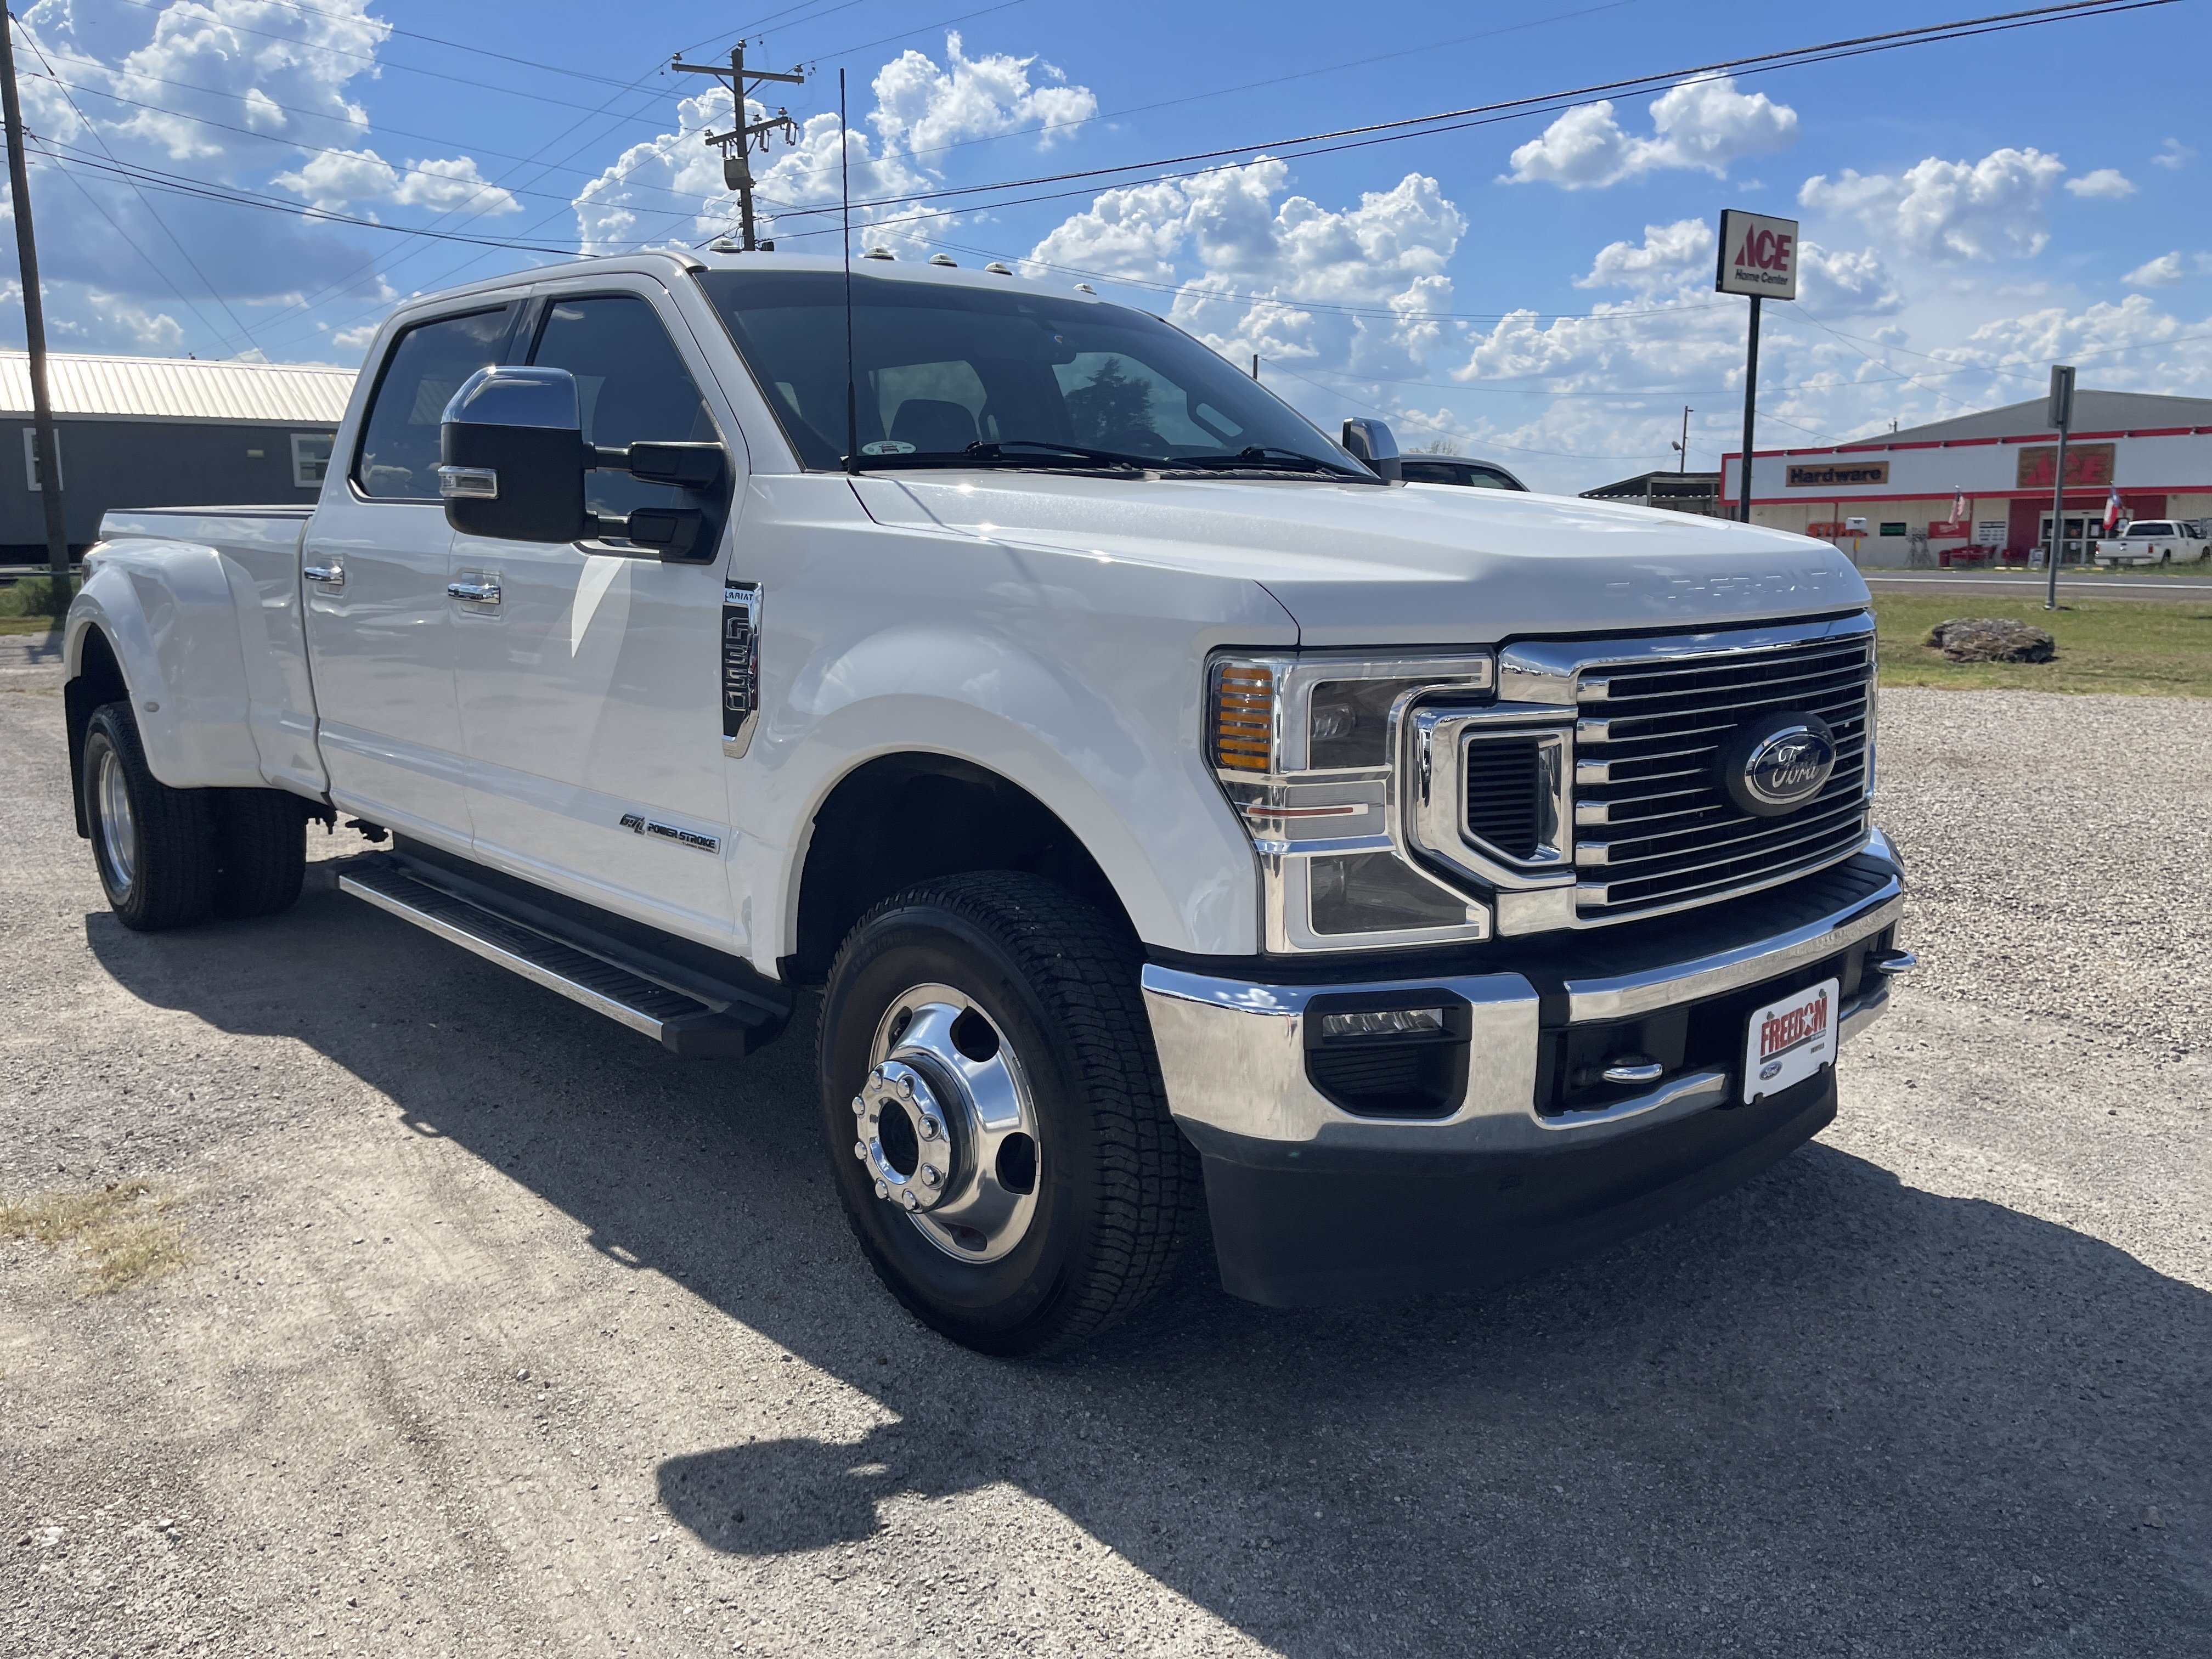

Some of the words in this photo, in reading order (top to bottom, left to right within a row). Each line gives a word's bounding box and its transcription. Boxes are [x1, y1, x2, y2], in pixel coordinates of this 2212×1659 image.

[1734, 222, 1792, 272] ACE
[1735, 269, 1760, 283] Home
[1760, 272, 1788, 285] Center
[1790, 468, 1882, 483] Hardware
[2025, 452, 2108, 484] ACE
[725, 589, 754, 601] LARIAT
[1772, 744, 1820, 788] Ford
[647, 822, 678, 839] POWER
[679, 831, 716, 849] STROKE
[1760, 996, 1827, 1057] FREEDOM
